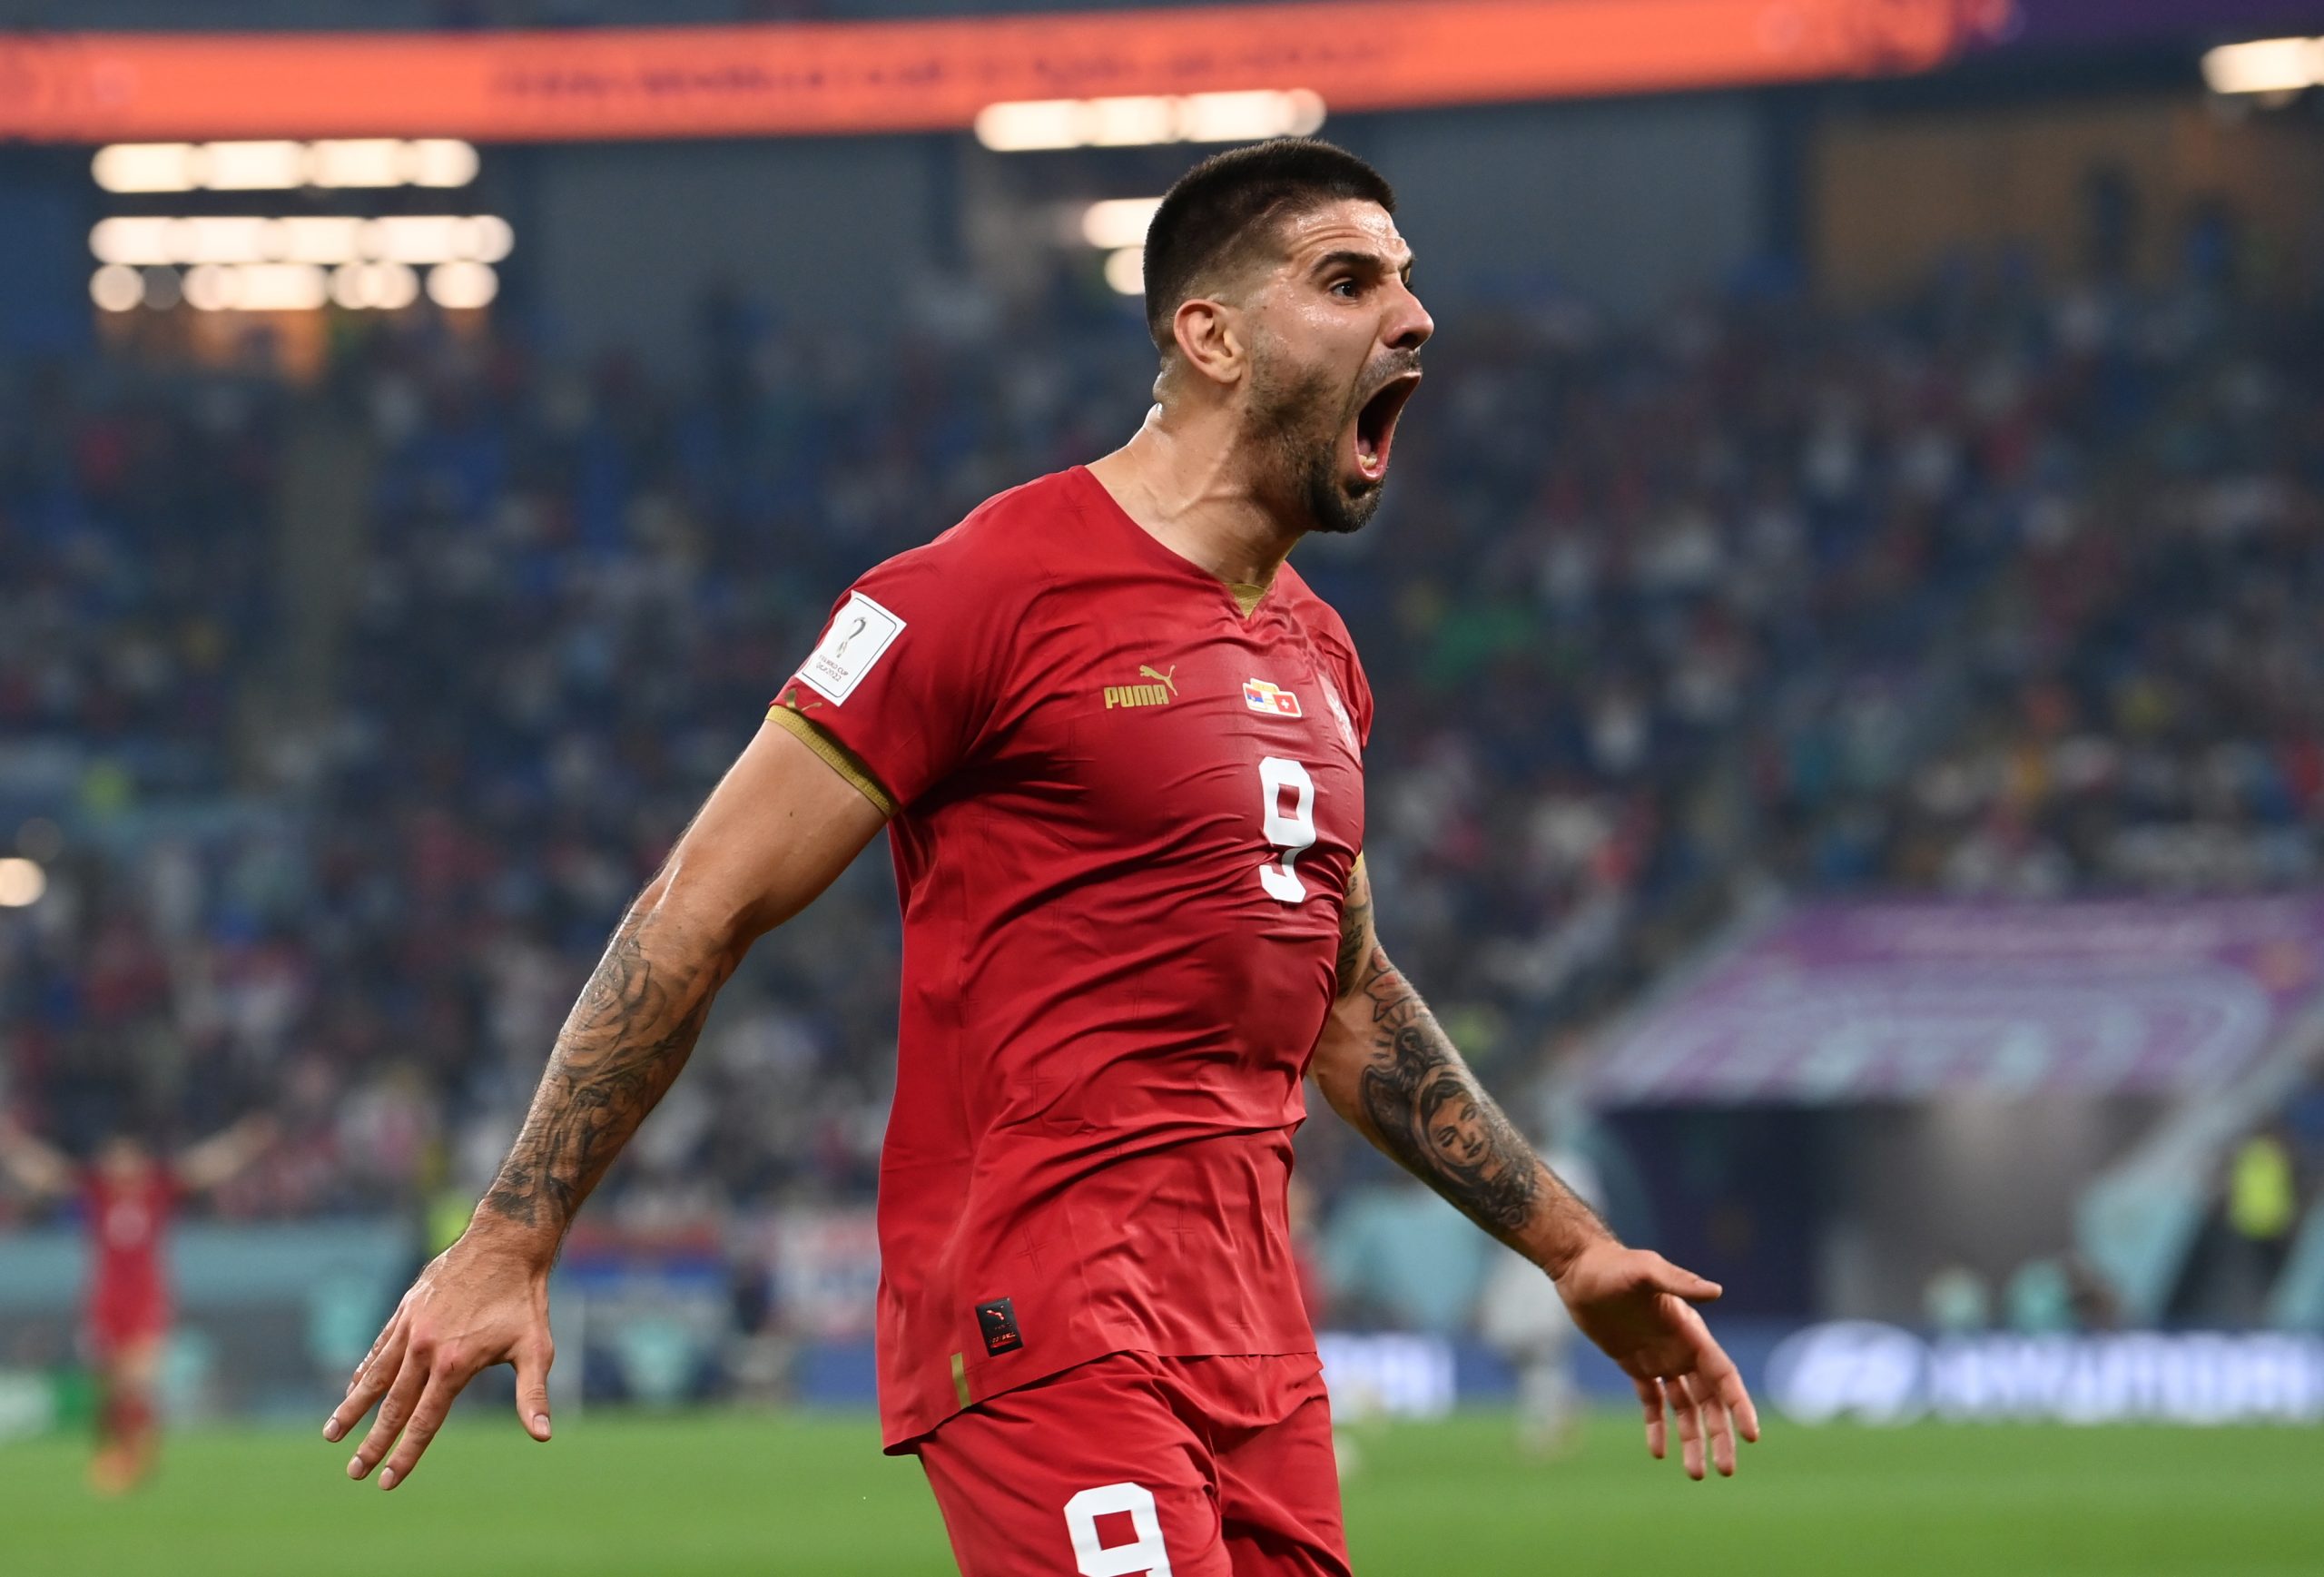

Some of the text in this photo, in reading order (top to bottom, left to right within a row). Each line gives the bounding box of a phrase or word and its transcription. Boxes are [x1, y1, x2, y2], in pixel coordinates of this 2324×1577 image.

[1104, 685, 1169, 709] PUMA
[1258, 756, 1316, 903] 9
[1063, 1482, 1173, 1577] 9
